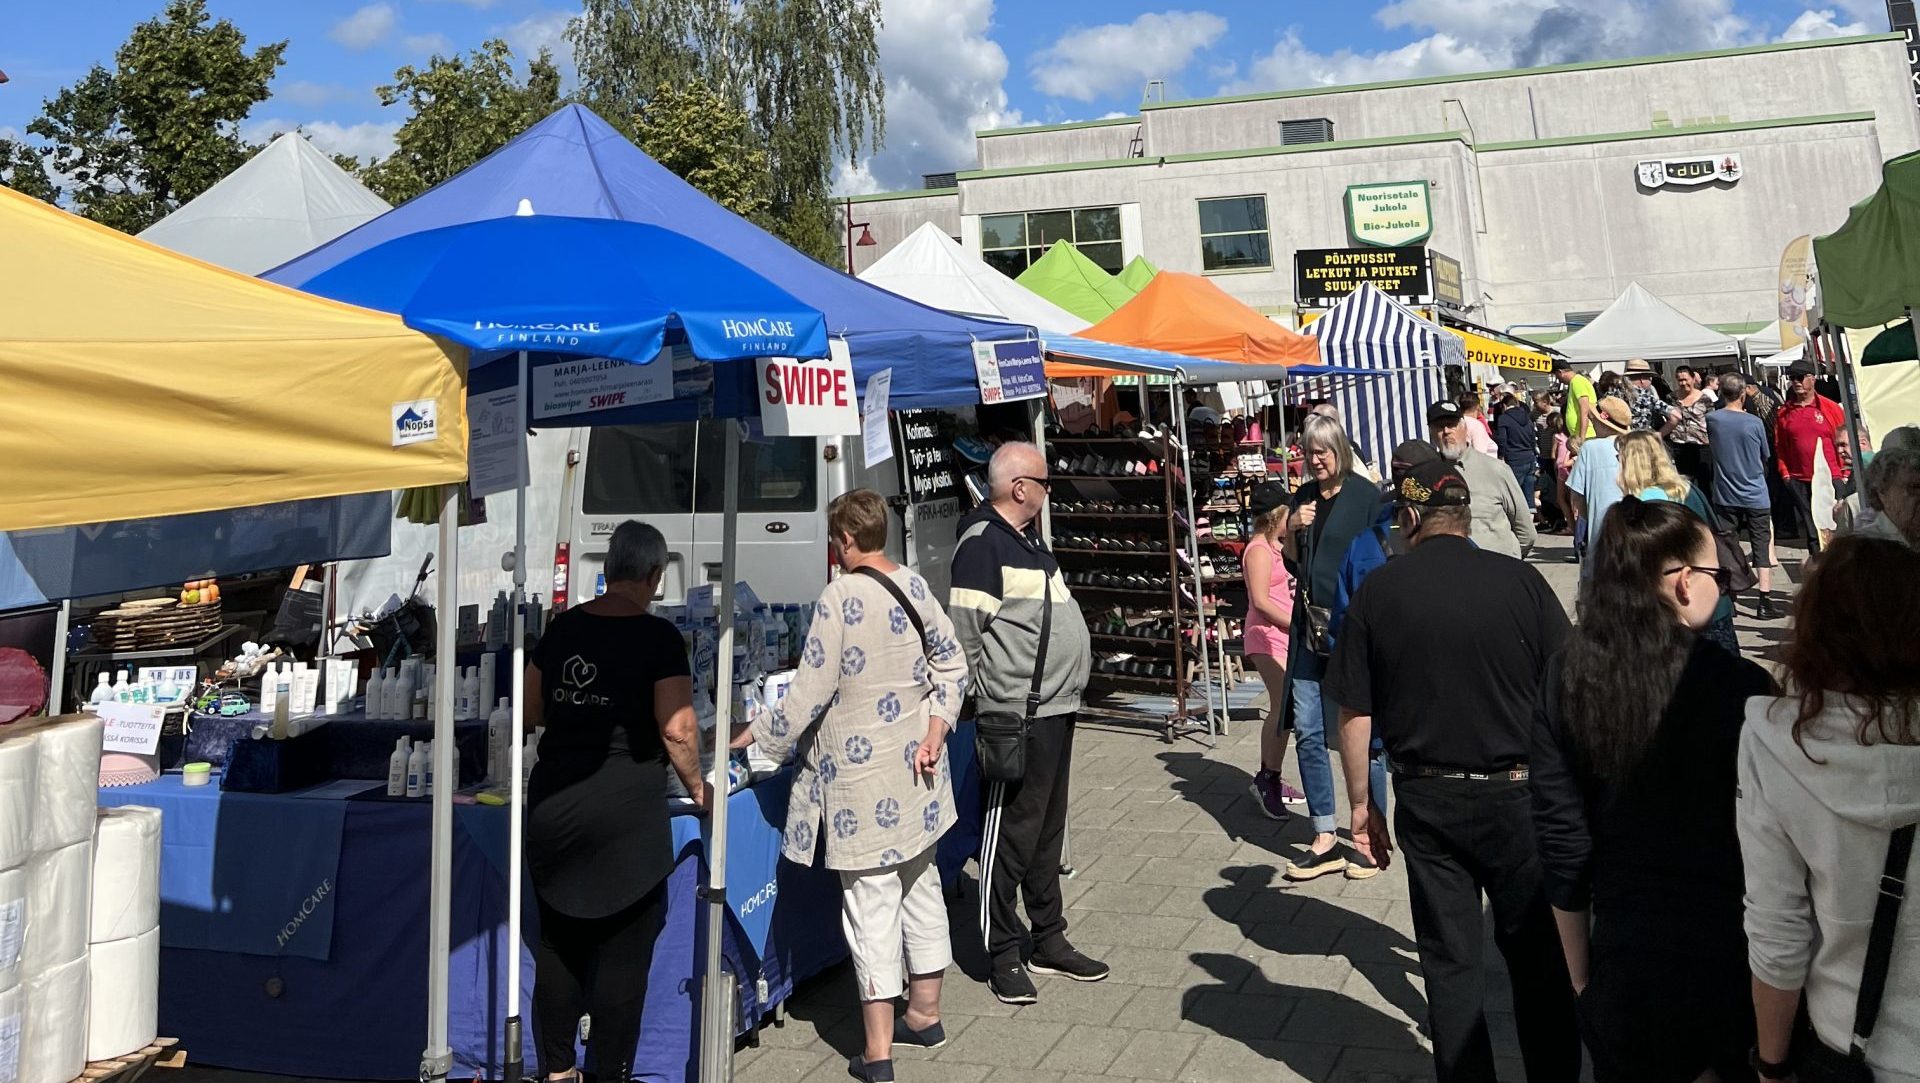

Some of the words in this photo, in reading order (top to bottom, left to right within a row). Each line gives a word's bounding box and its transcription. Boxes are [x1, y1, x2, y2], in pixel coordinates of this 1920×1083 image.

[1358, 190, 1419, 202] Nuorisotalo
[1372, 202, 1408, 212] Jukola
[1363, 220, 1420, 231] Bio-Jukola
[1325, 252, 1396, 265] PÖLYPUSSIT
[1305, 268, 1350, 279] LETKUT
[1371, 265, 1417, 277] PUTKET
[498, 334, 579, 346] FINLAND
[742, 342, 787, 351] FINLAND
[1467, 350, 1550, 370] PÖLYPUSSIT
[765, 363, 848, 406] SWIPE
[544, 399, 582, 412] bioswipe
[589, 392, 626, 408] SWIPE
[405, 420, 434, 431] Nopsa
[120, 736, 148, 744] KORISSA
